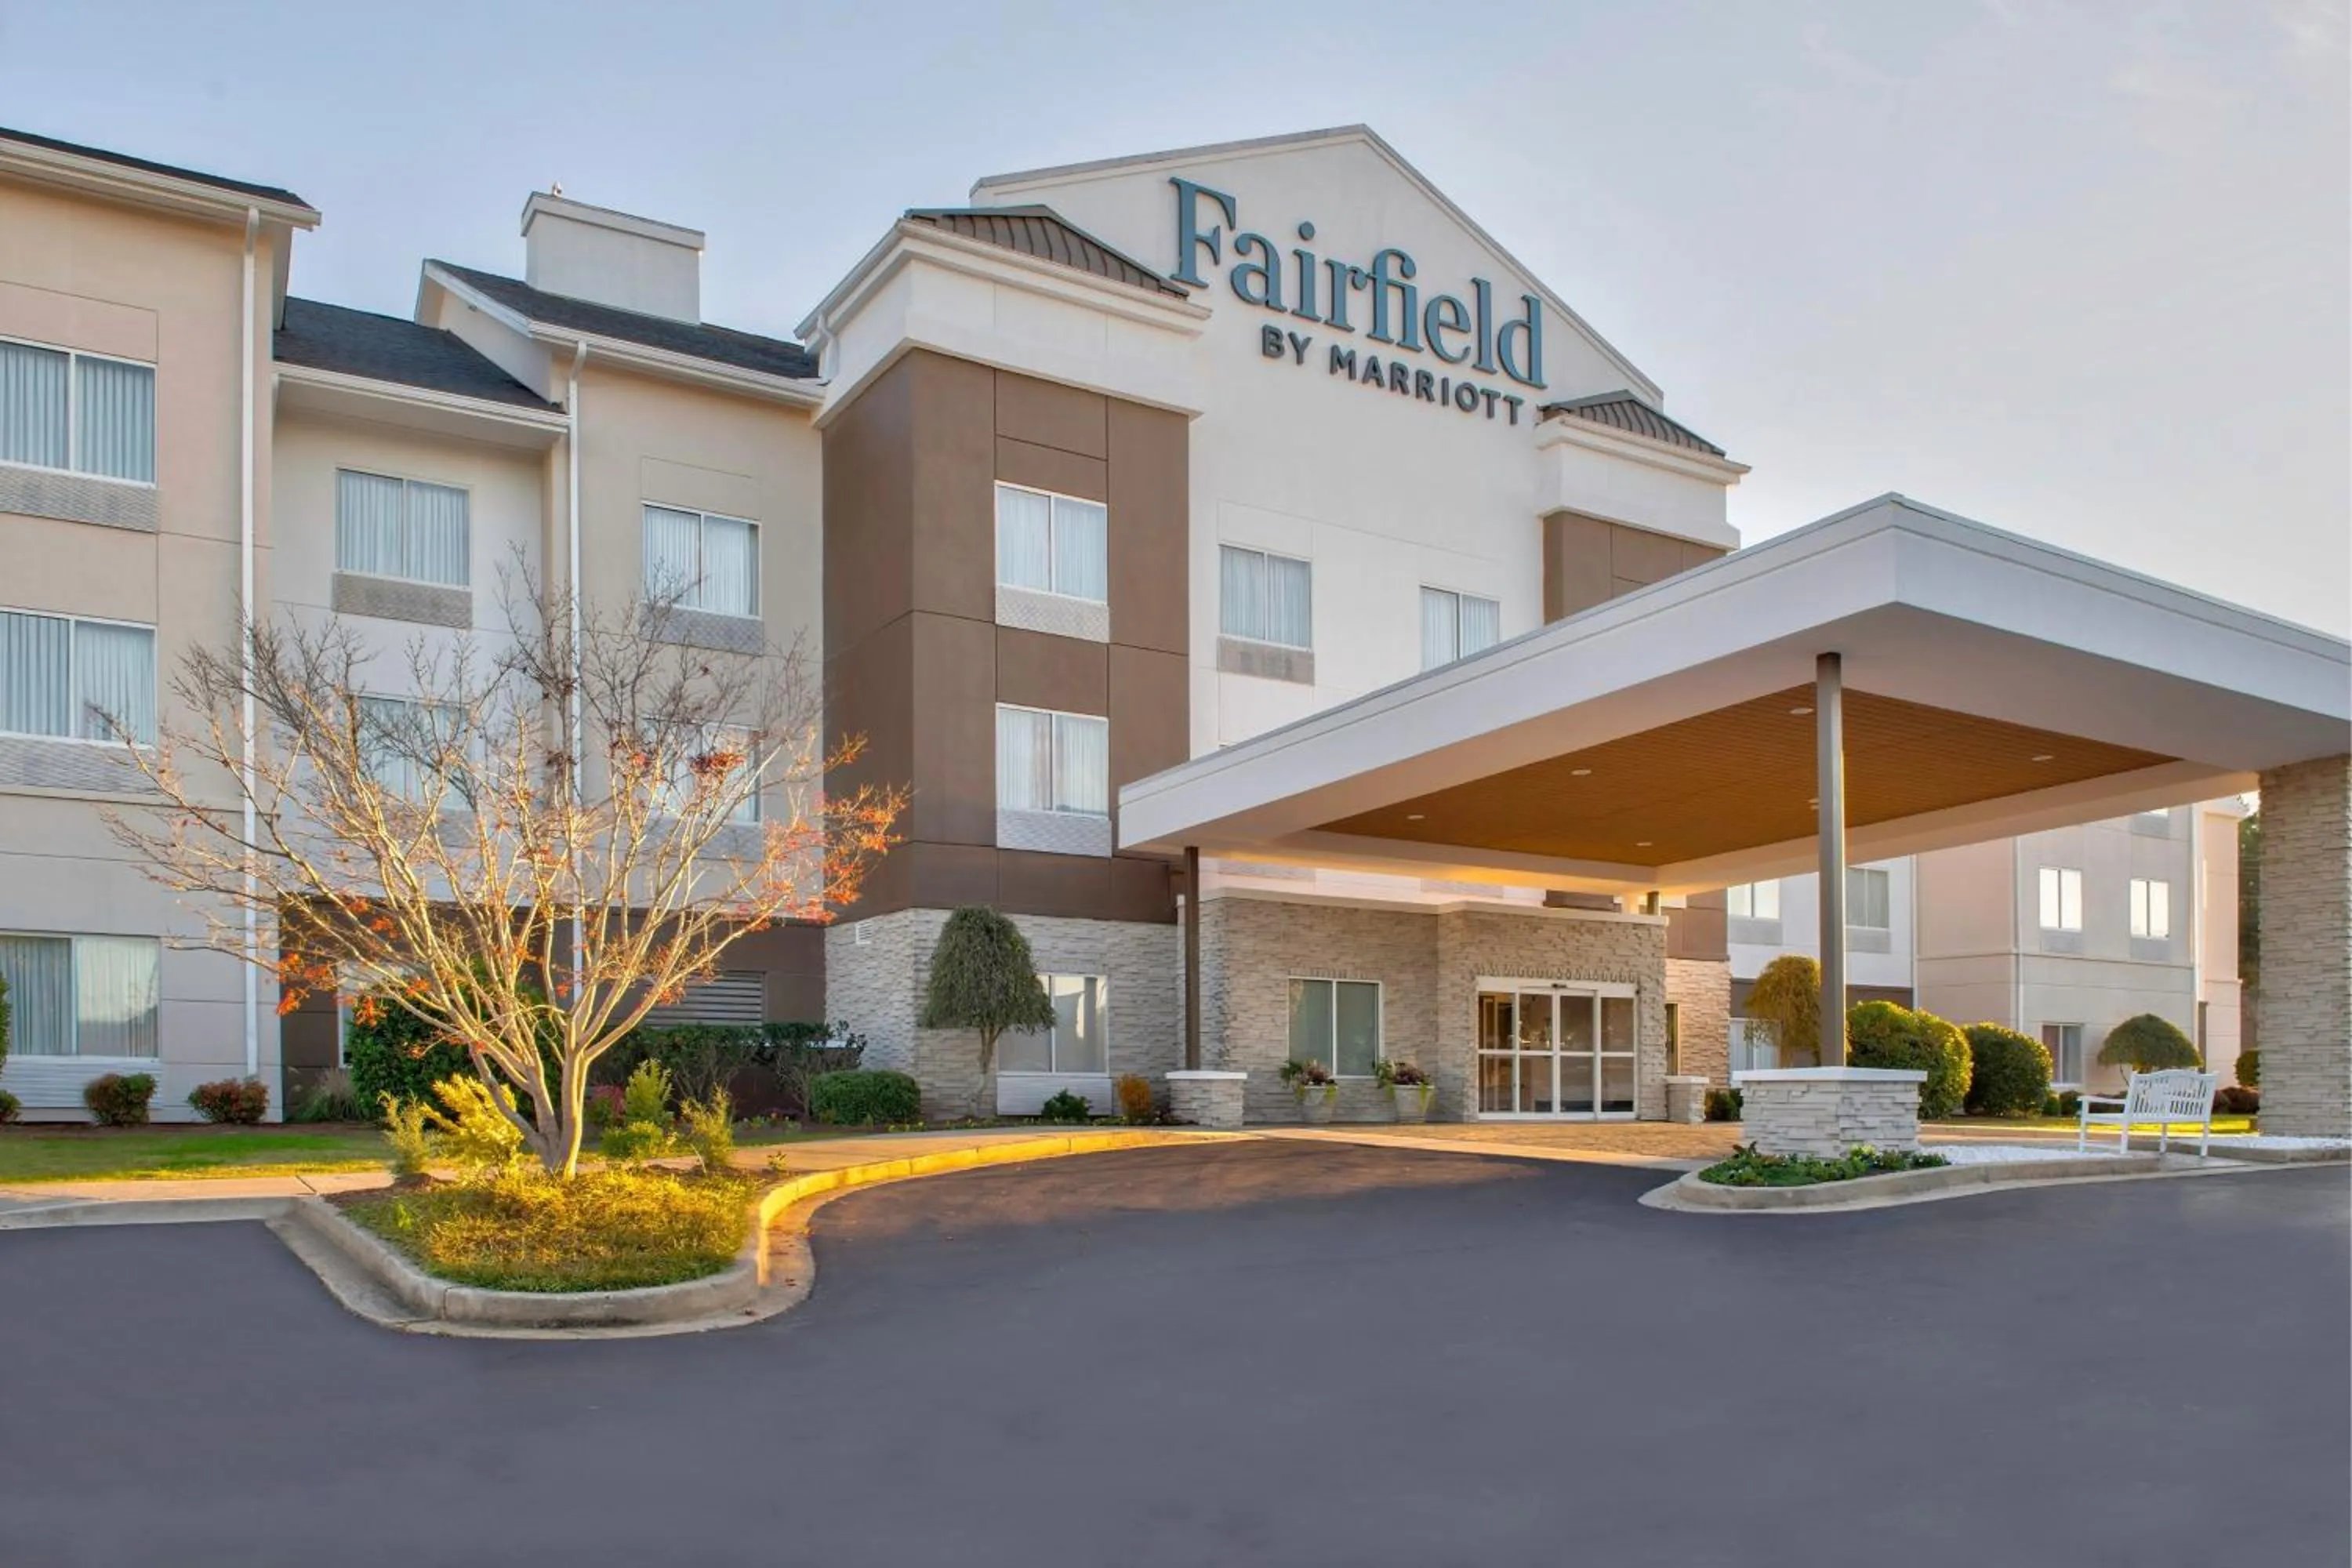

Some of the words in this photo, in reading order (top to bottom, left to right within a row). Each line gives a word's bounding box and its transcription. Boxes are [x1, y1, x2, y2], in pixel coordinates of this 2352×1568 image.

[1169, 176, 1548, 389] Fairfield
[1261, 324, 1312, 365] BY
[1330, 344, 1525, 425] MARRIOTT
